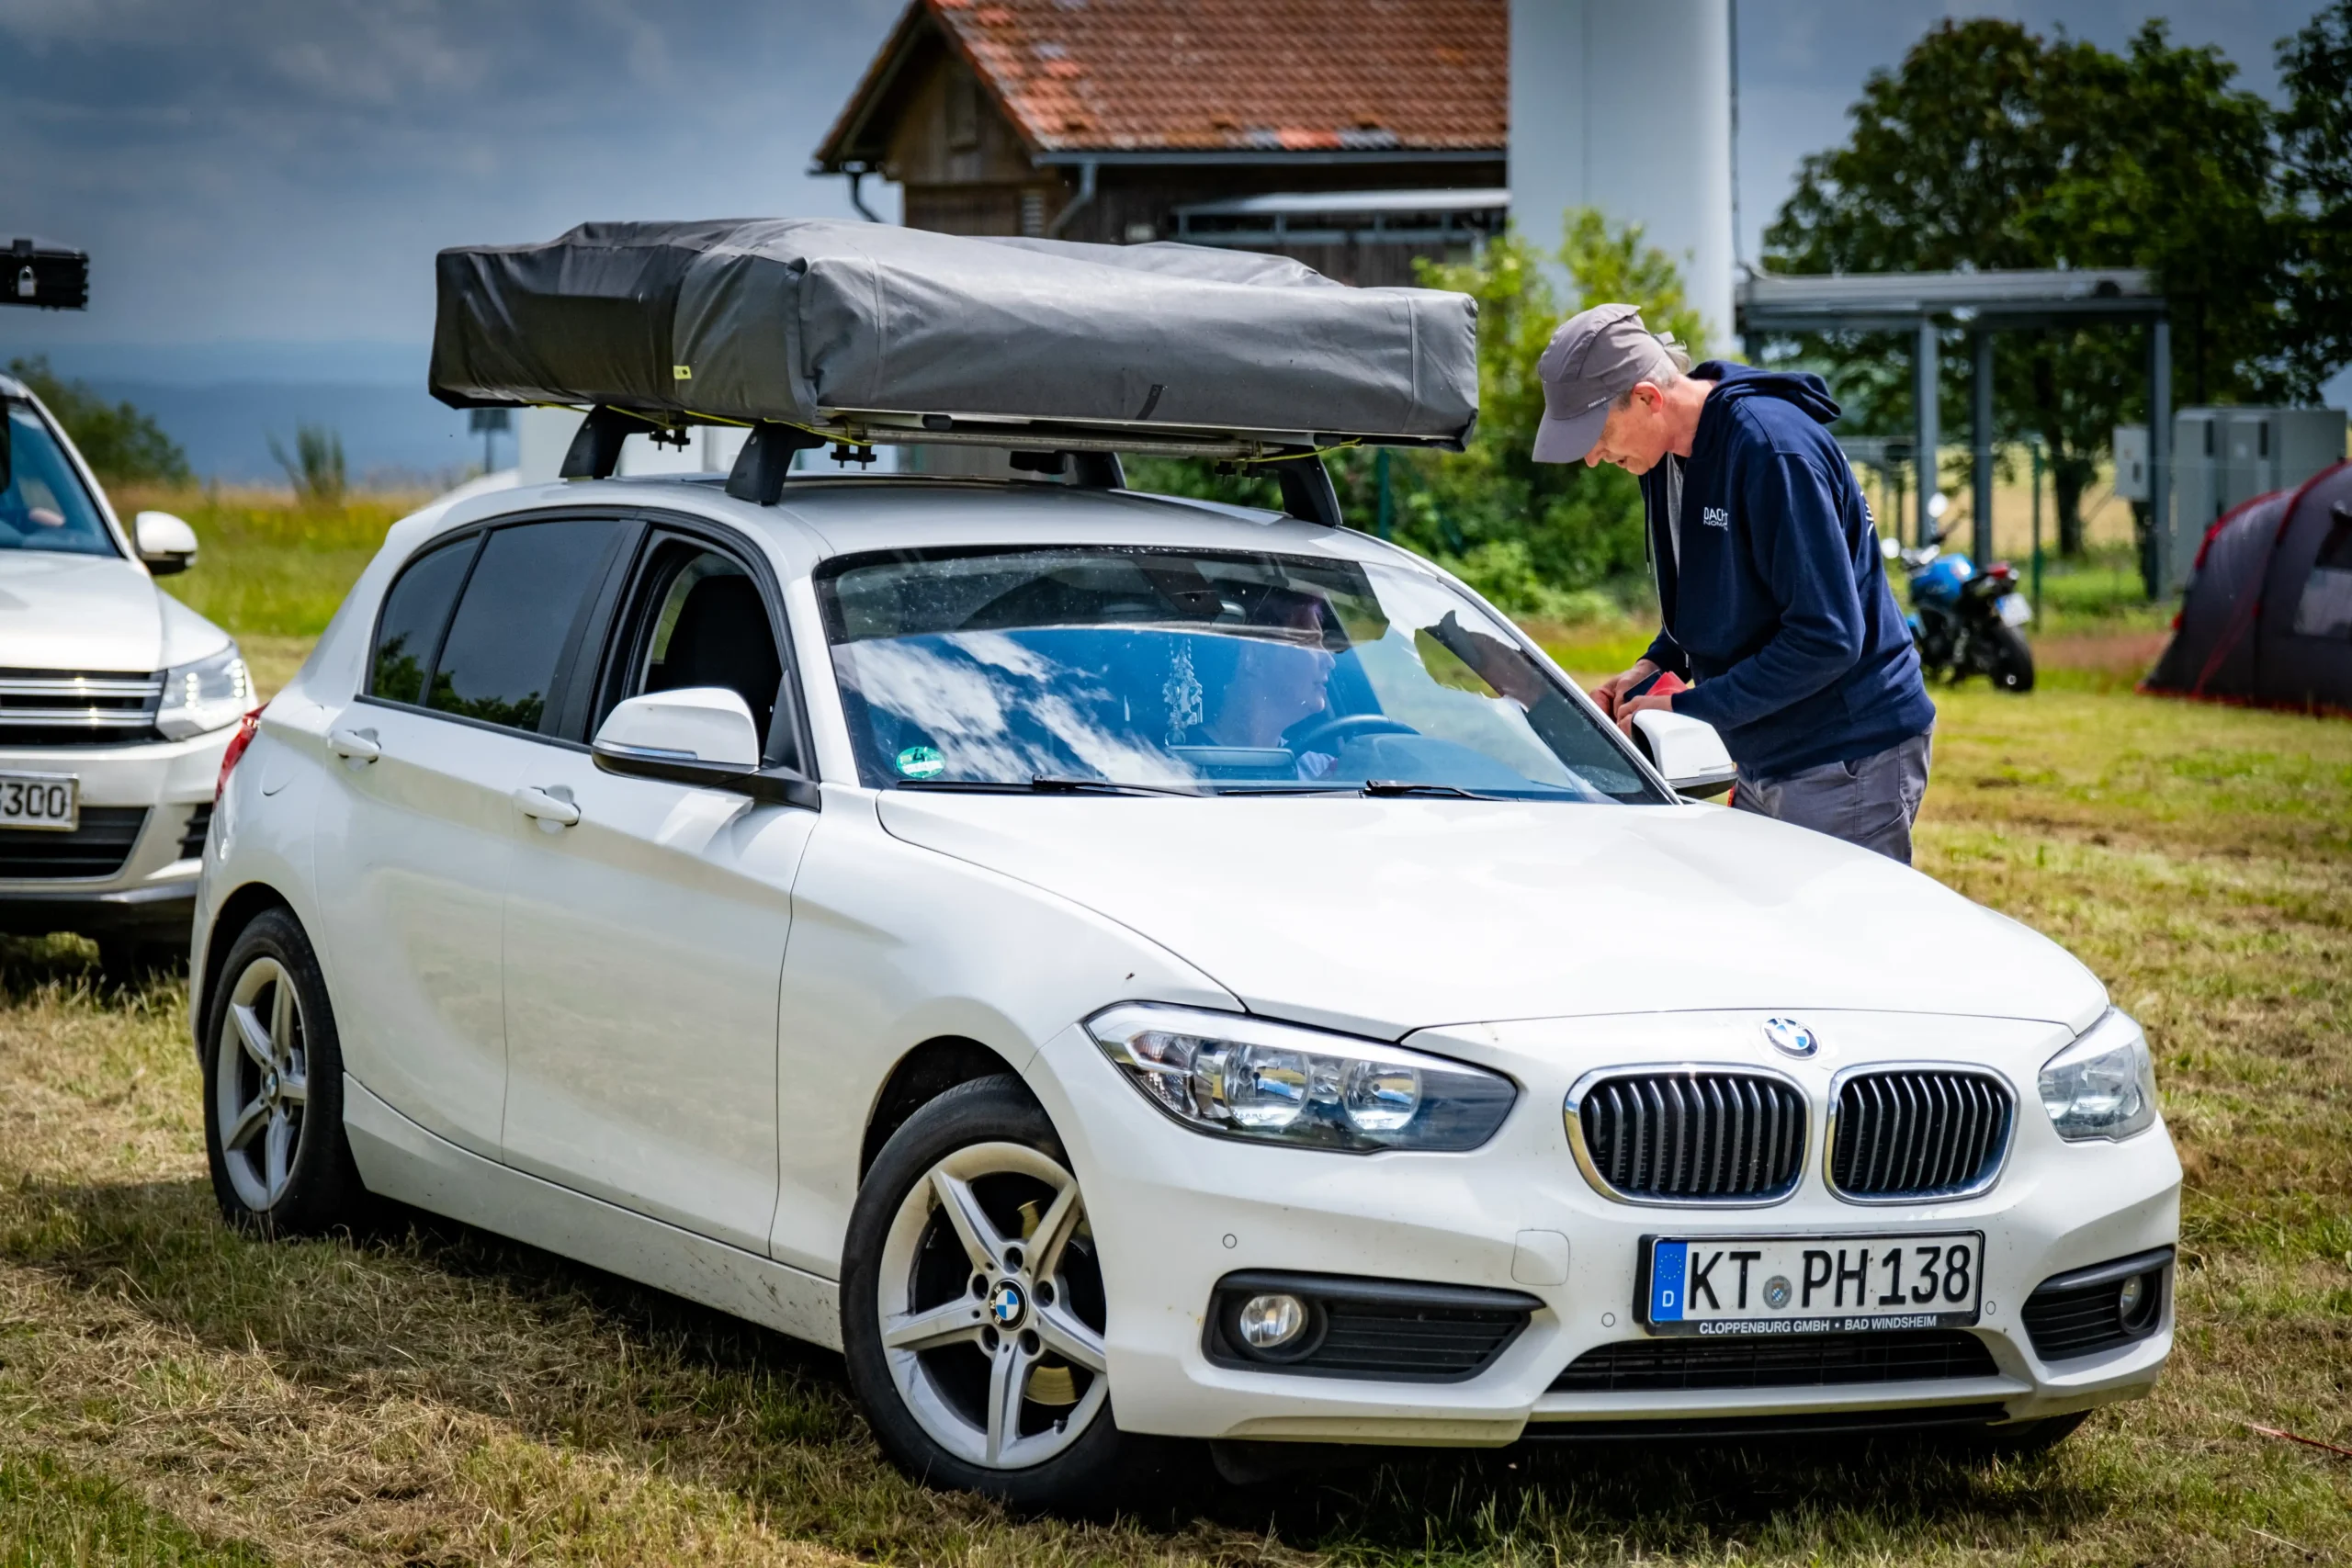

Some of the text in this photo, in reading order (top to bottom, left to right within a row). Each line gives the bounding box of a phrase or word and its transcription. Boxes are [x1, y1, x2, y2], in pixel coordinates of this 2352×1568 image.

[912, 748, 926, 761] 4
[0, 783, 66, 818] 300
[1689, 1251, 1761, 1310] KT
[1662, 1290, 1675, 1308] D
[1699, 1314, 1938, 1335] CLOPPENBURG GMBH BAD WINDSHEIM
